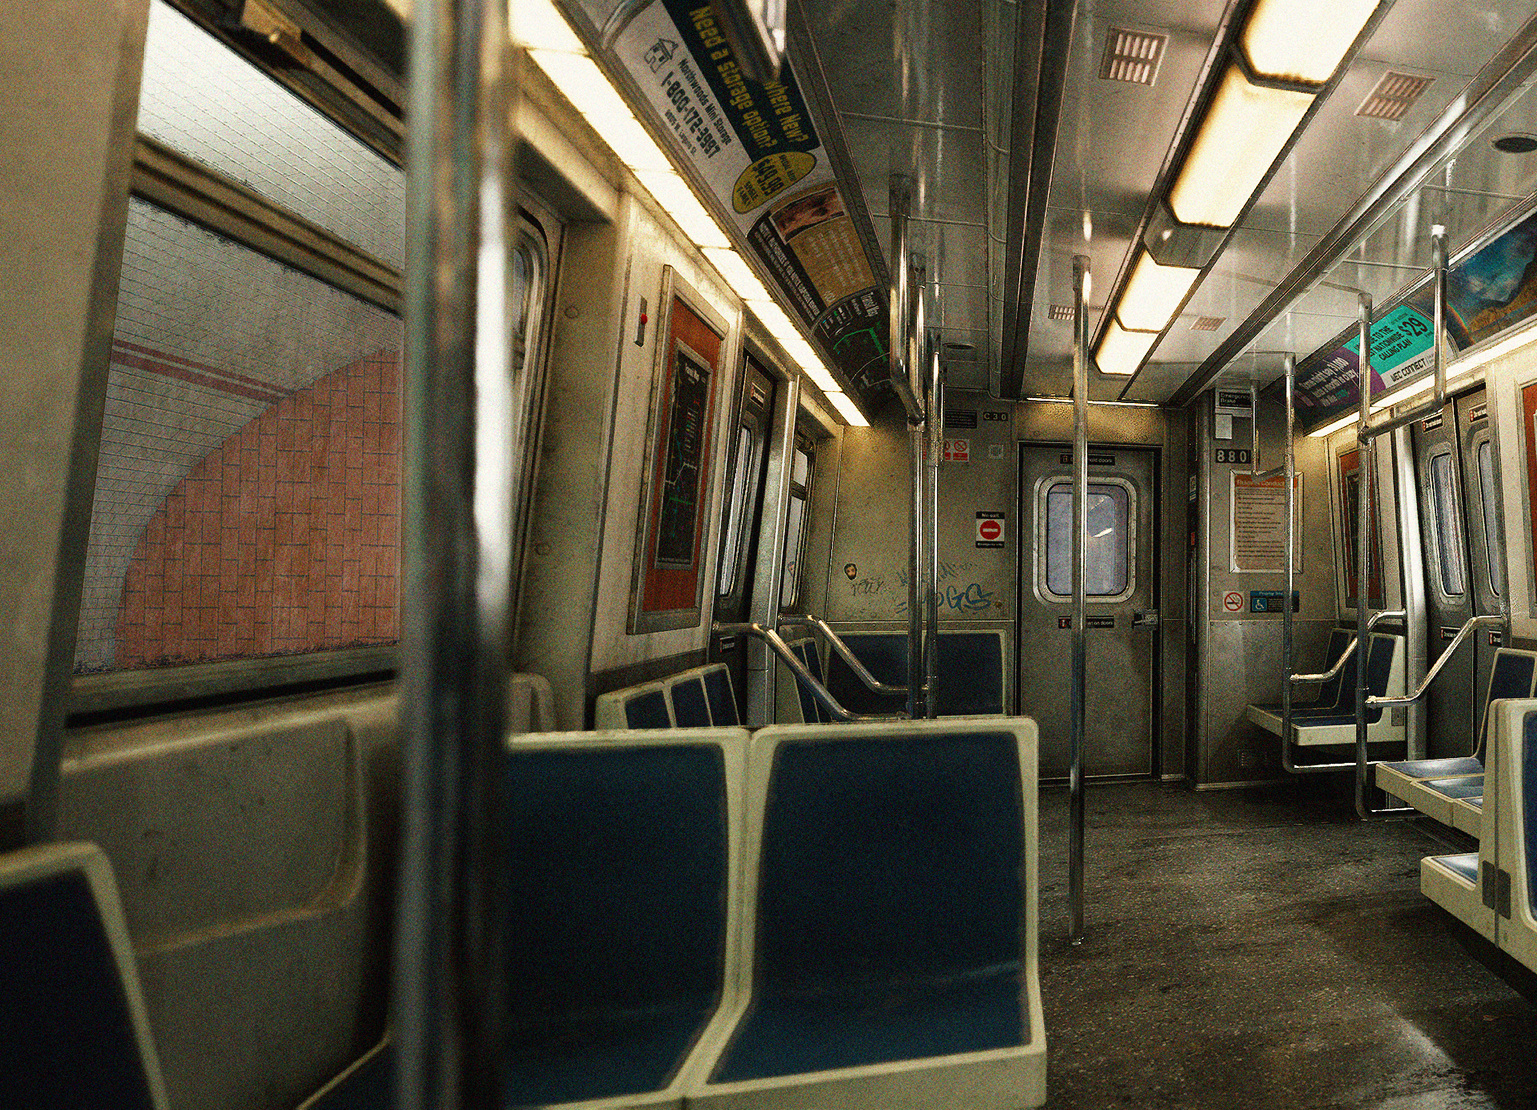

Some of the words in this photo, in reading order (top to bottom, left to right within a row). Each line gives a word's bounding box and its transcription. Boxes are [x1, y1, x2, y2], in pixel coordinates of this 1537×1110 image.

[689, 5, 725, 48] Need
[711, 48, 728, 60] a
[678, 58, 711, 106] Northwoods
[705, 104, 718, 121] Mini
[713, 117, 731, 146] Storage
[717, 61, 754, 110] storage
[742, 110, 778, 148] option?
[781, 113, 809, 142] New?
[753, 158, 785, 197] $49.99
[1397, 317, 1428, 337] $29
[983, 412, 1007, 421] C30
[1217, 450, 1247, 462] 880
